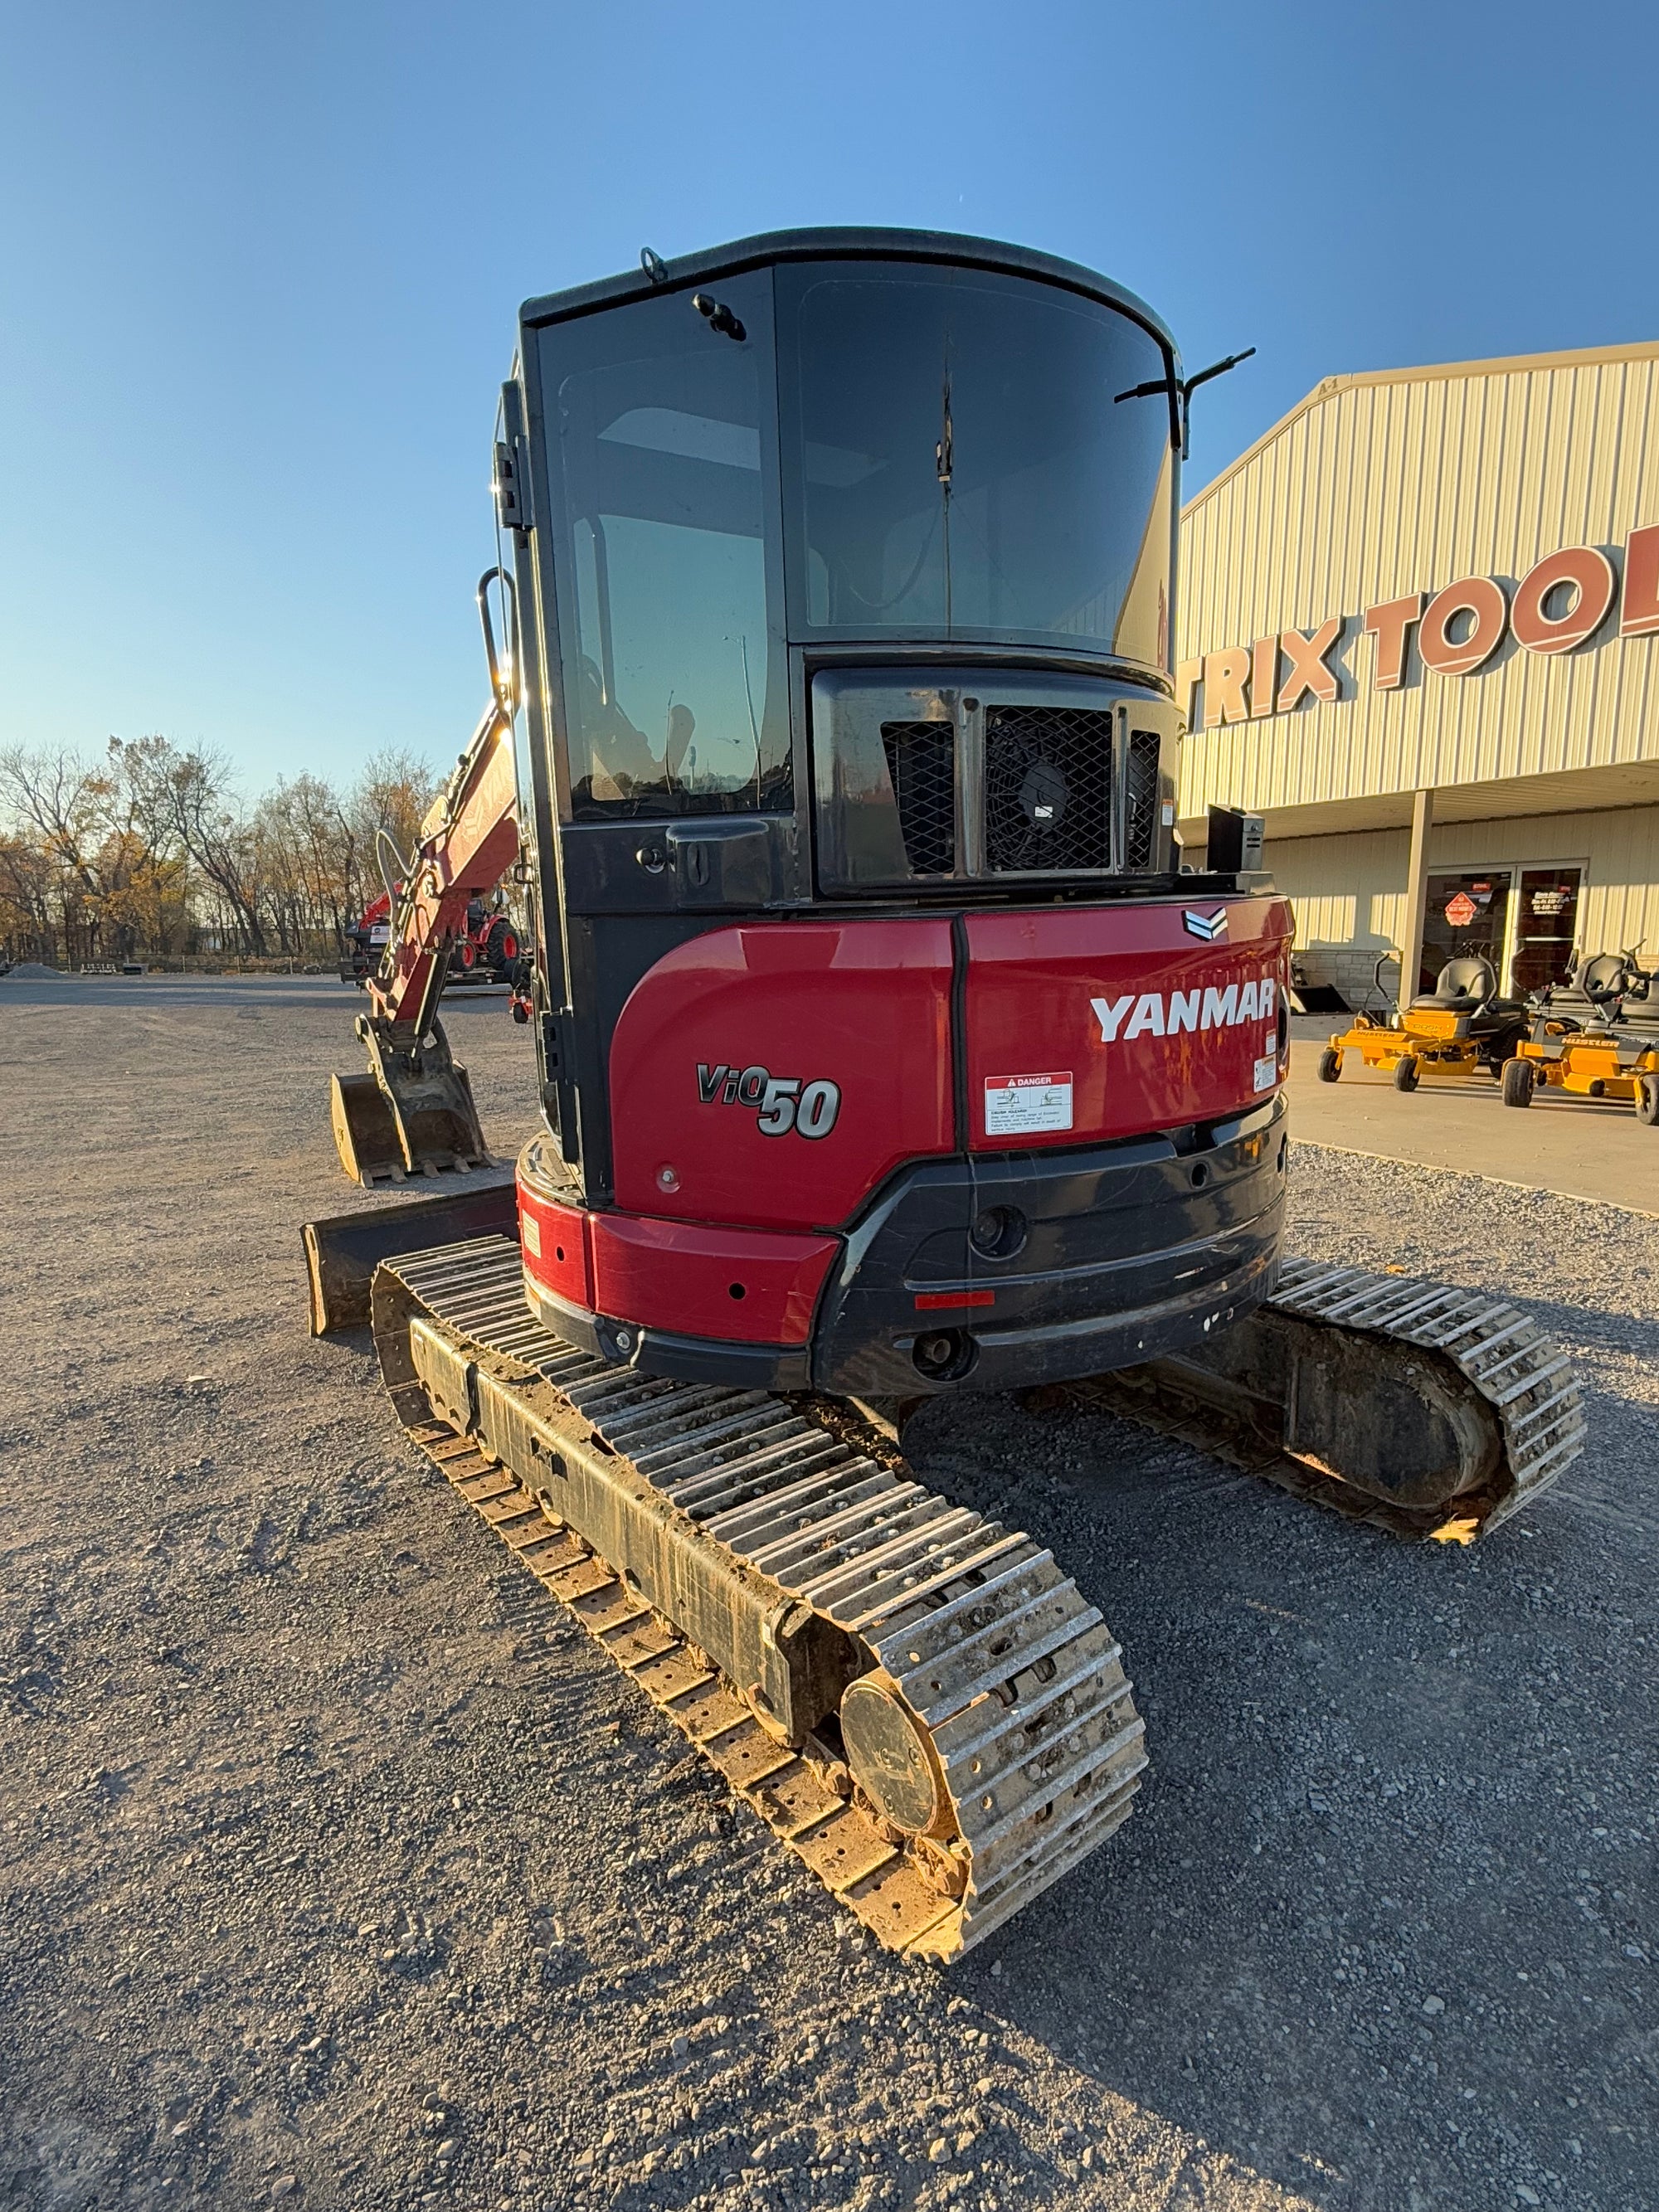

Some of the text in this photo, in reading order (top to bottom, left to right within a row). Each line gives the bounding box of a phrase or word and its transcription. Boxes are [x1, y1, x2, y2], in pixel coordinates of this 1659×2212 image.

[1090, 978, 1274, 1043] YANMAR
[1561, 1038, 1620, 1048] HUSTLER
[1017, 1077, 1052, 1087] DANGER
